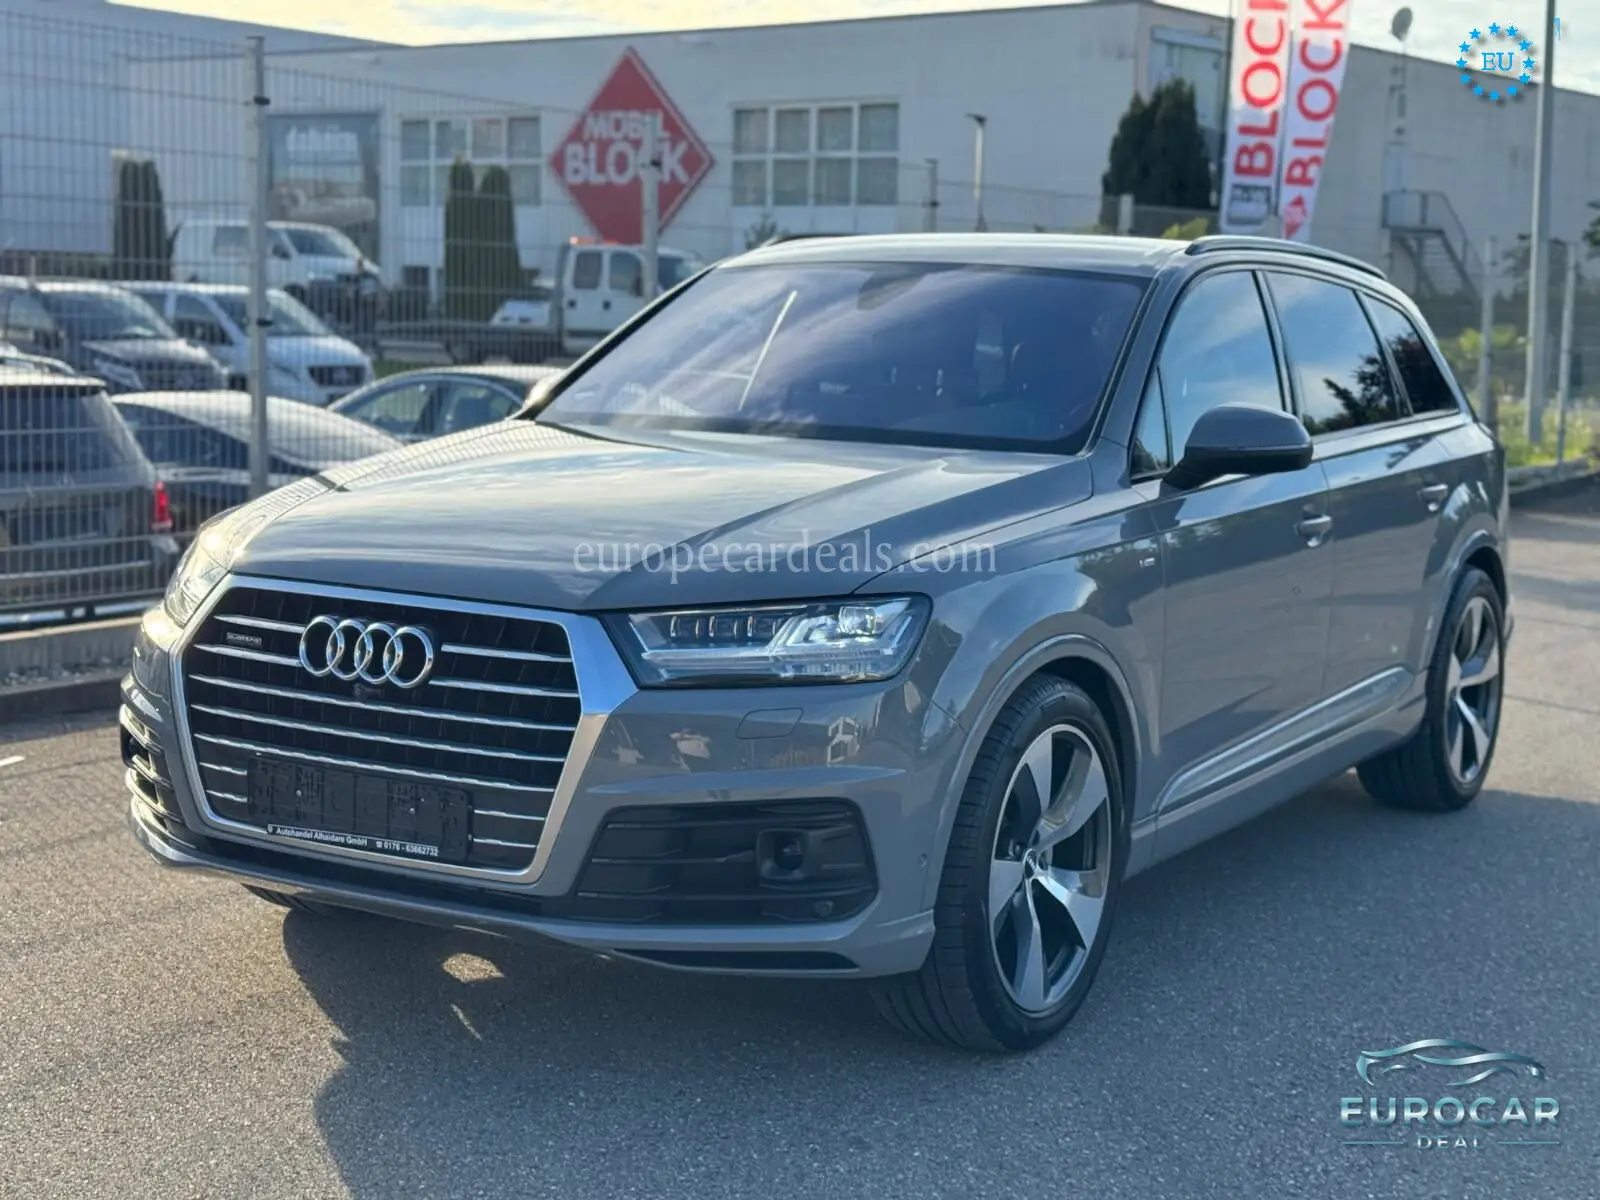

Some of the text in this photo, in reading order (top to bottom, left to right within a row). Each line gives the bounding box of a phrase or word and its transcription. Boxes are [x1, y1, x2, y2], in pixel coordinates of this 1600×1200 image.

[1234, 0, 1288, 177] BLOC
[582, 108, 670, 140] MOBL
[276, 826, 313, 839] Autohandel
[346, 836, 368, 847] GmbH
